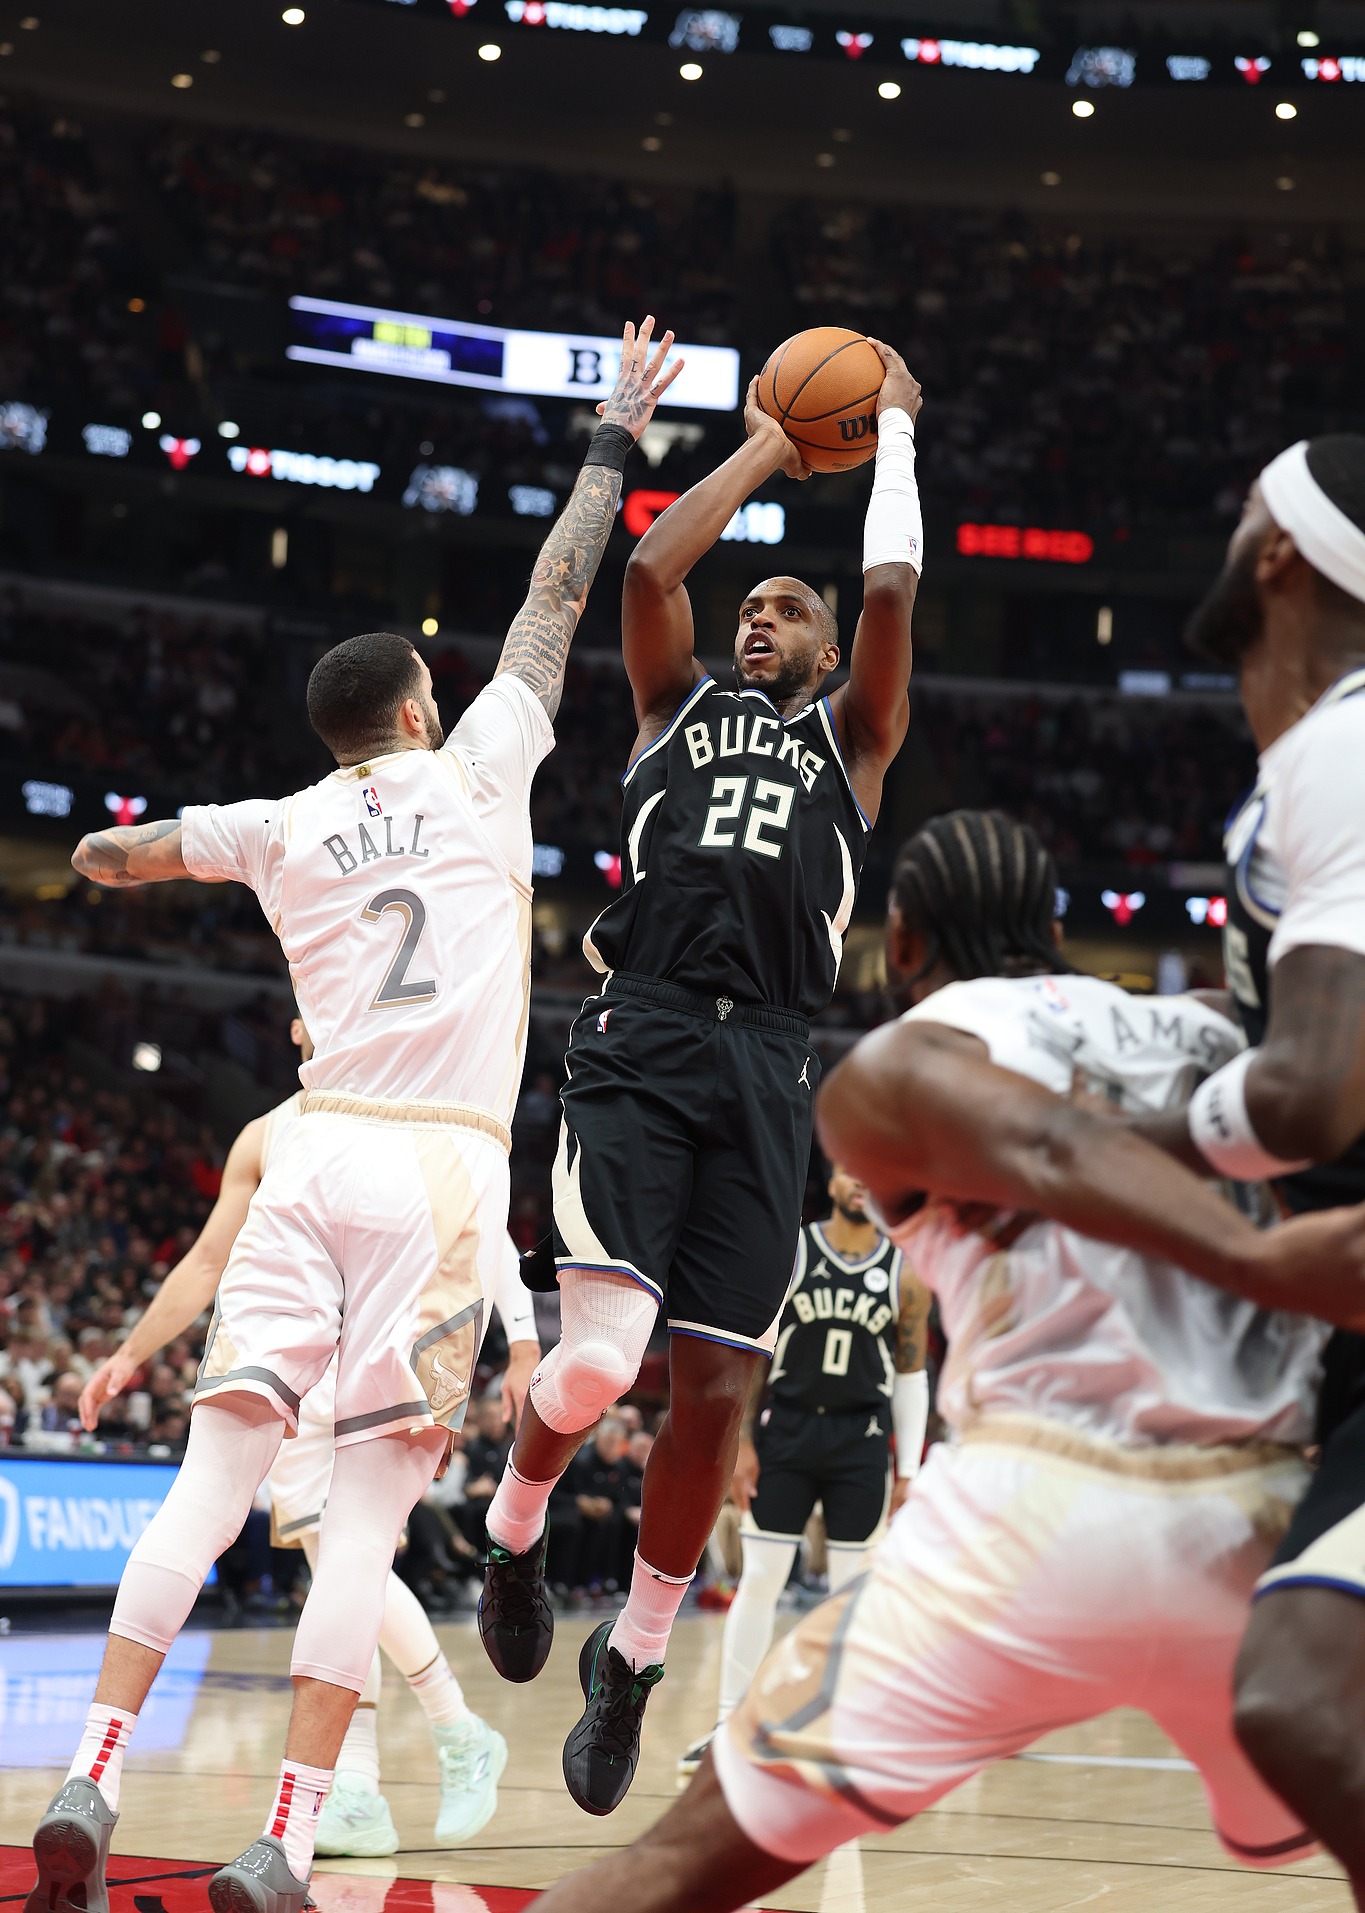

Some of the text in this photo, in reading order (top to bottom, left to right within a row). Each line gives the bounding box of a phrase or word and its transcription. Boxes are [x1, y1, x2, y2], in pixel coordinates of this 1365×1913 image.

[684, 714, 827, 795] BUCKS
[322, 813, 430, 877] BALL
[697, 774, 798, 861] 22
[359, 887, 438, 1013] 2
[792, 1286, 893, 1336] BUCKS
[821, 1327, 854, 1377] 0
